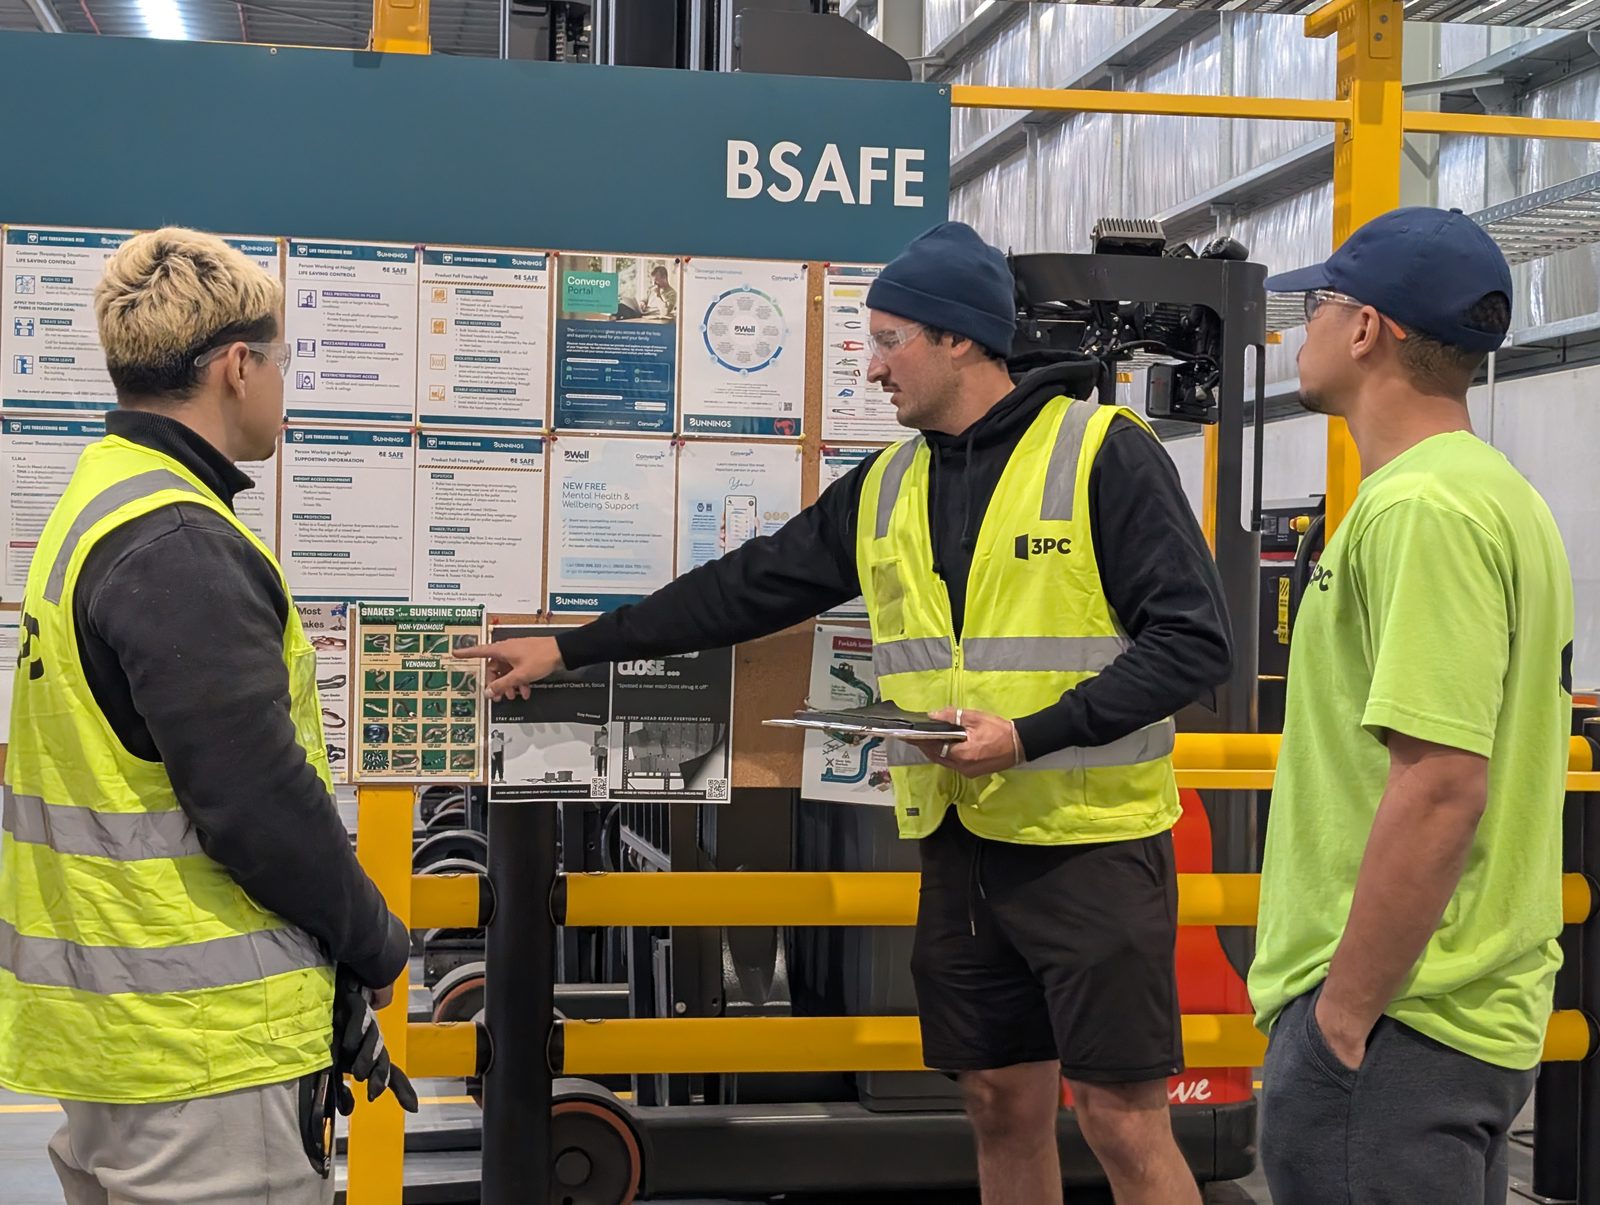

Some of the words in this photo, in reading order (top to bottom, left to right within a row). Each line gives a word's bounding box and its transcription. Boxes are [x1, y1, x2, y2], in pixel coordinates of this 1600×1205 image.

[727, 140, 924, 206] BSAFE
[377, 250, 408, 259] BUNNINGS
[568, 276, 610, 288] Converge
[568, 286, 593, 295] Portal
[689, 418, 731, 428] BUNNINGS
[585, 482, 606, 491] FREE
[562, 500, 602, 510] Wellbeing
[605, 501, 639, 510] Support
[1031, 538, 1072, 554] 3PC
[556, 596, 598, 605] BUNNINGS
[361, 607, 394, 616] SNAKES
[410, 608, 452, 616] SUNSHINE
[455, 608, 482, 617] COAST
